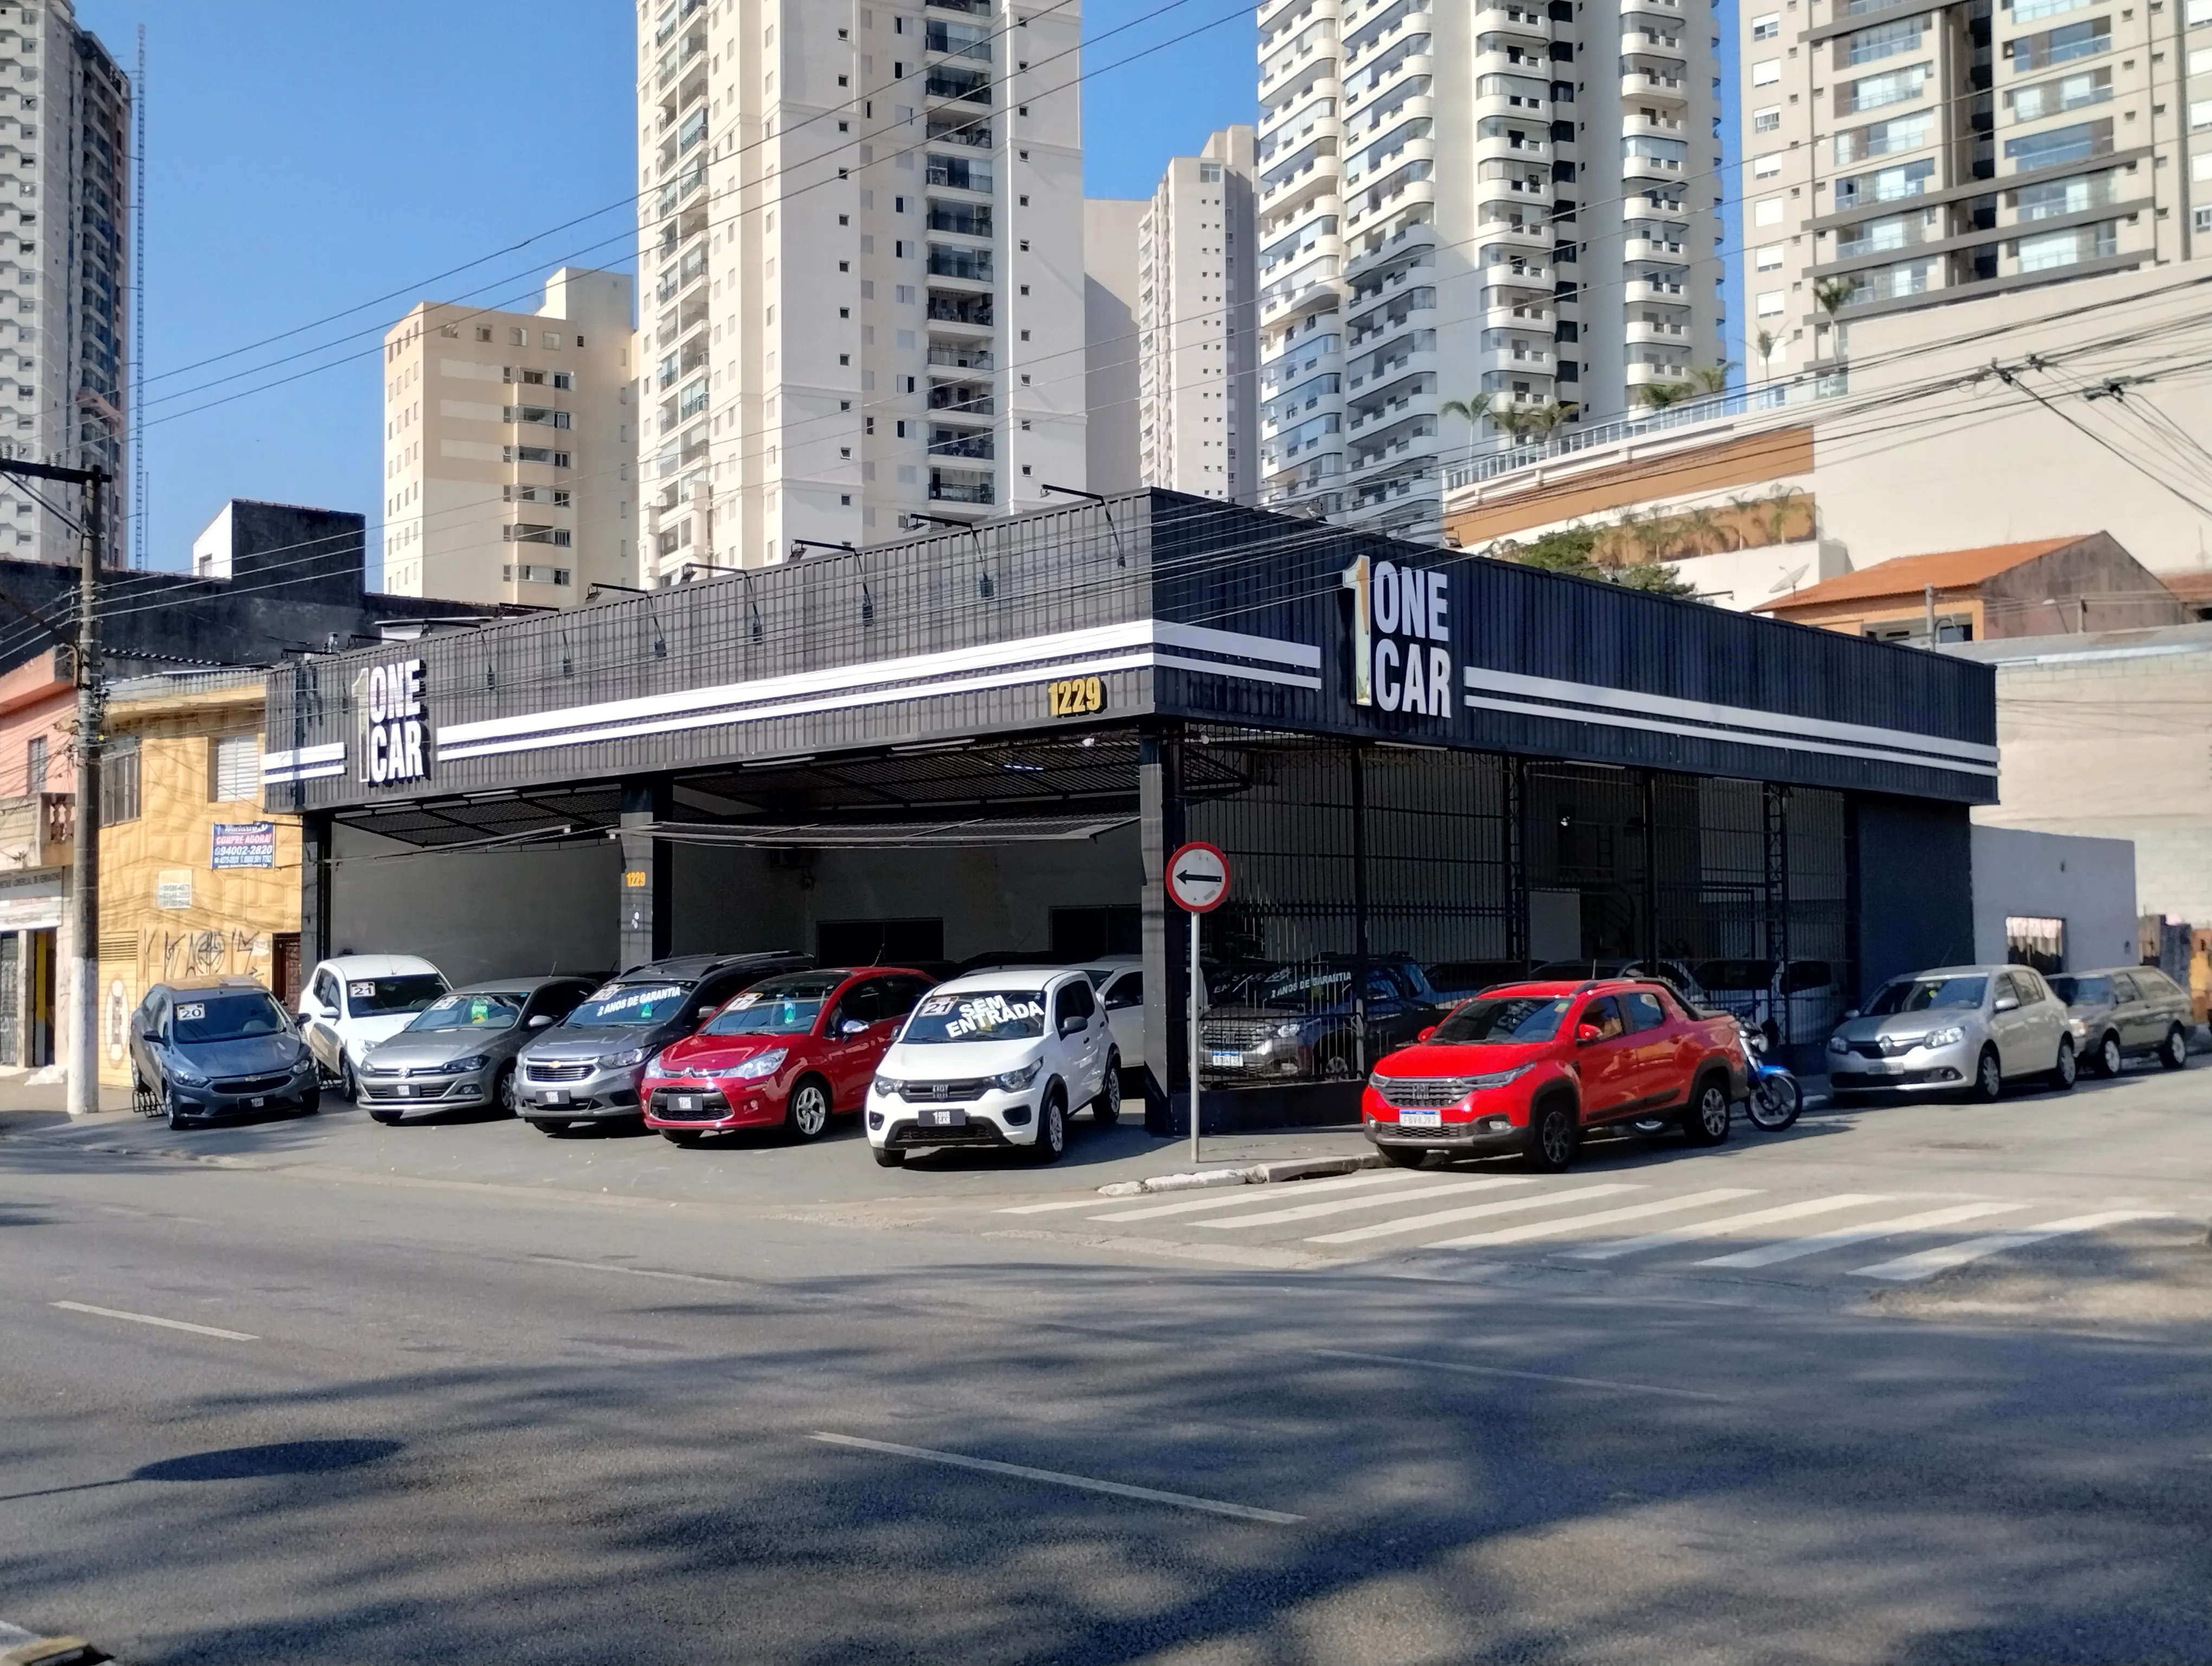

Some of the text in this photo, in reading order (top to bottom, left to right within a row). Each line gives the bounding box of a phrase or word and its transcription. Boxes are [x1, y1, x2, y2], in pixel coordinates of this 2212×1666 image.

[1374, 561, 1449, 642] ONE
[370, 659, 421, 723] ONE
[1375, 638, 1451, 719] CAR
[1048, 676, 1101, 716] 1229
[371, 720, 424, 783] CAR
[216, 835, 244, 845] COMPRE
[220, 845, 273, 856] 94002-2820
[626, 871, 645, 887] 1229
[354, 987, 371, 995] 21
[1277, 982, 1298, 996] ANOS
[1300, 979, 1310, 989] DE
[1312, 971, 1352, 986] GARANTIA
[182, 1009, 202, 1018] 20
[597, 1005, 604, 1017] 2
[603, 998, 627, 1015] ANOS
[627, 995, 639, 1008] DE
[639, 986, 681, 1003] GARANTIA
[924, 1002, 950, 1014] 21
[959, 995, 1007, 1018] SEM
[945, 1001, 1045, 1038] ENTRADA
